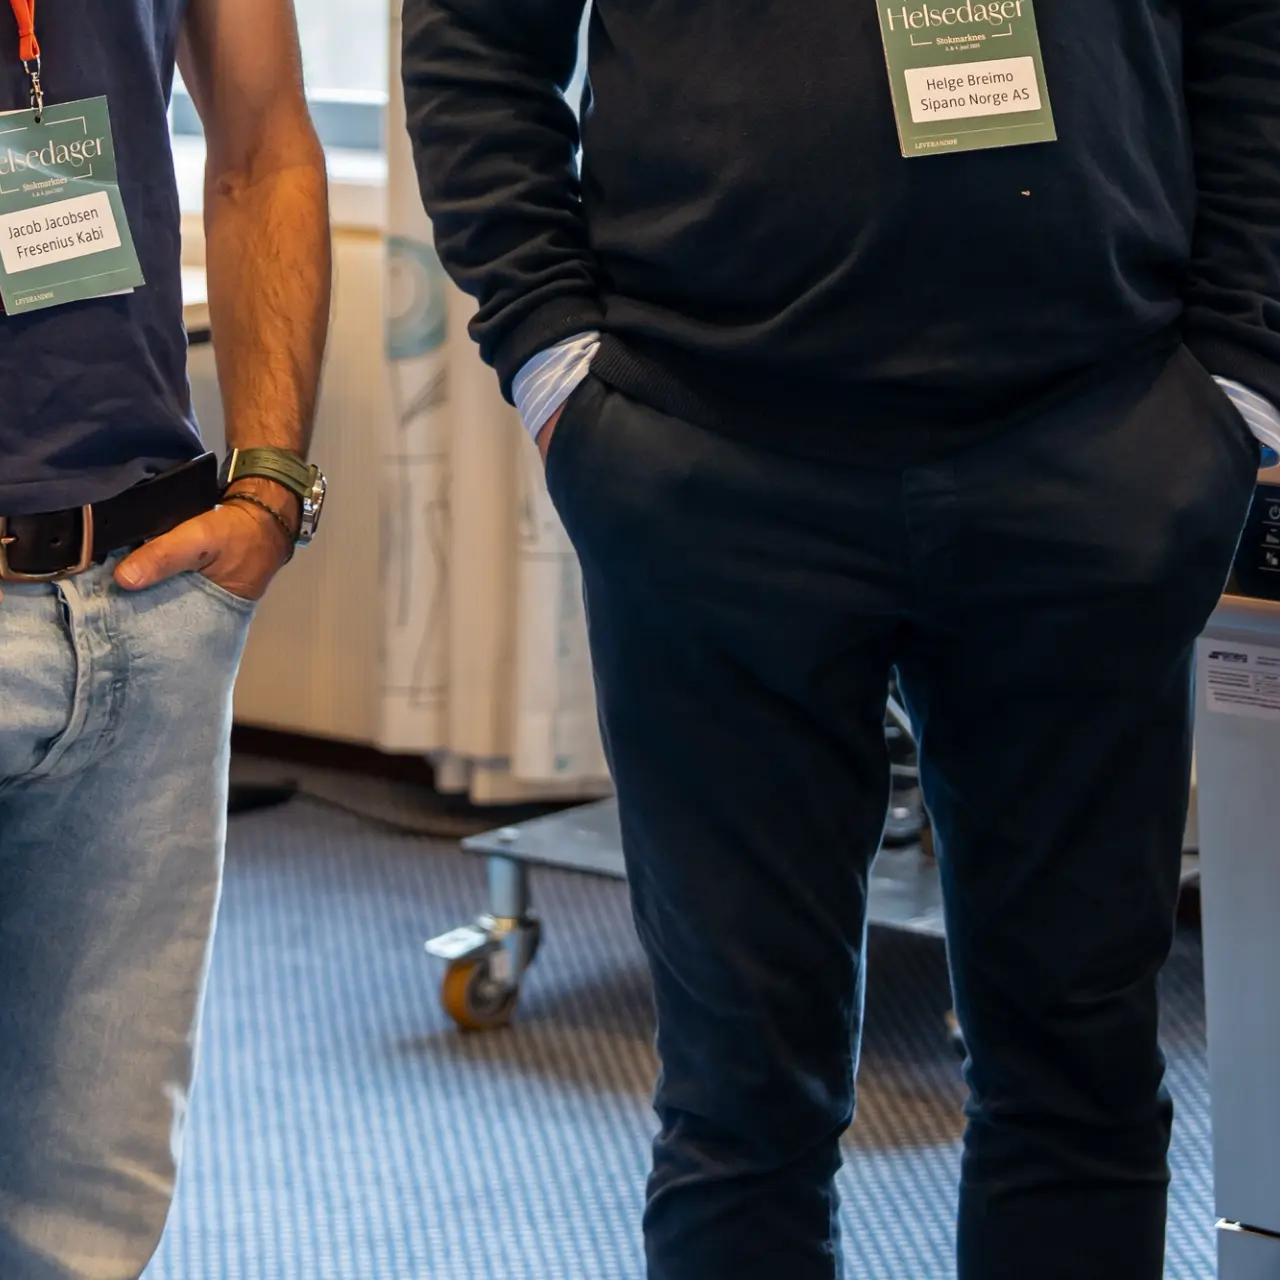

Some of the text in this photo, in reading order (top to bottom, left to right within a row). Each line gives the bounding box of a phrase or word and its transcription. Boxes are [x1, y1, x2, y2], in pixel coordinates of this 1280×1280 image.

[887, 0, 1025, 31] Helsedager
[936, 33, 987, 45] Stokmarknes
[926, 71, 1014, 92] Helge Breimo
[920, 87, 1030, 112] Sipano Norge AS
[8, 207, 99, 239] Jacob Jacobsen
[16, 226, 104, 259] Fresenius Kabi
